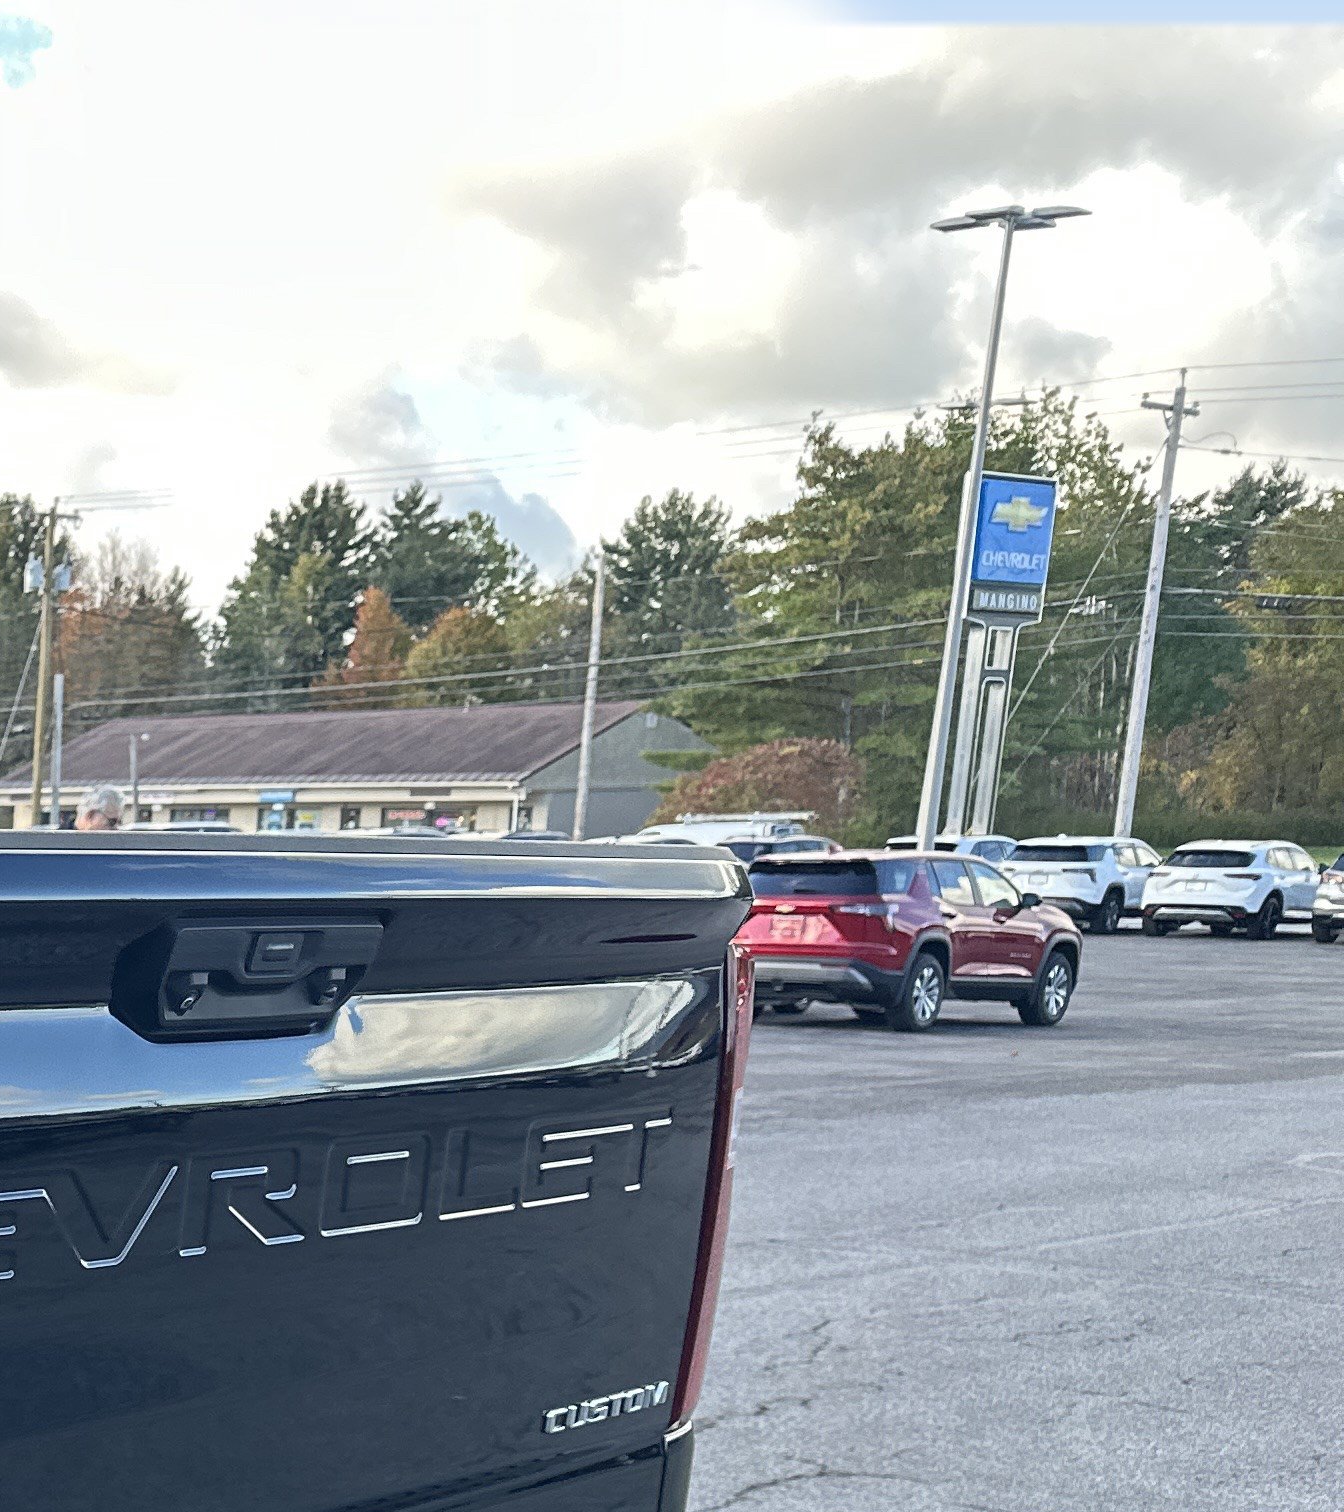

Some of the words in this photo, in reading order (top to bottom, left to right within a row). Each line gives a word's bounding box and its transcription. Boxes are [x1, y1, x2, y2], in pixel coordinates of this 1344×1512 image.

[982, 551, 1047, 570] CHEVROLET
[978, 592, 1038, 610] MANGINO
[542, 1381, 669, 1434] CUSTOM
